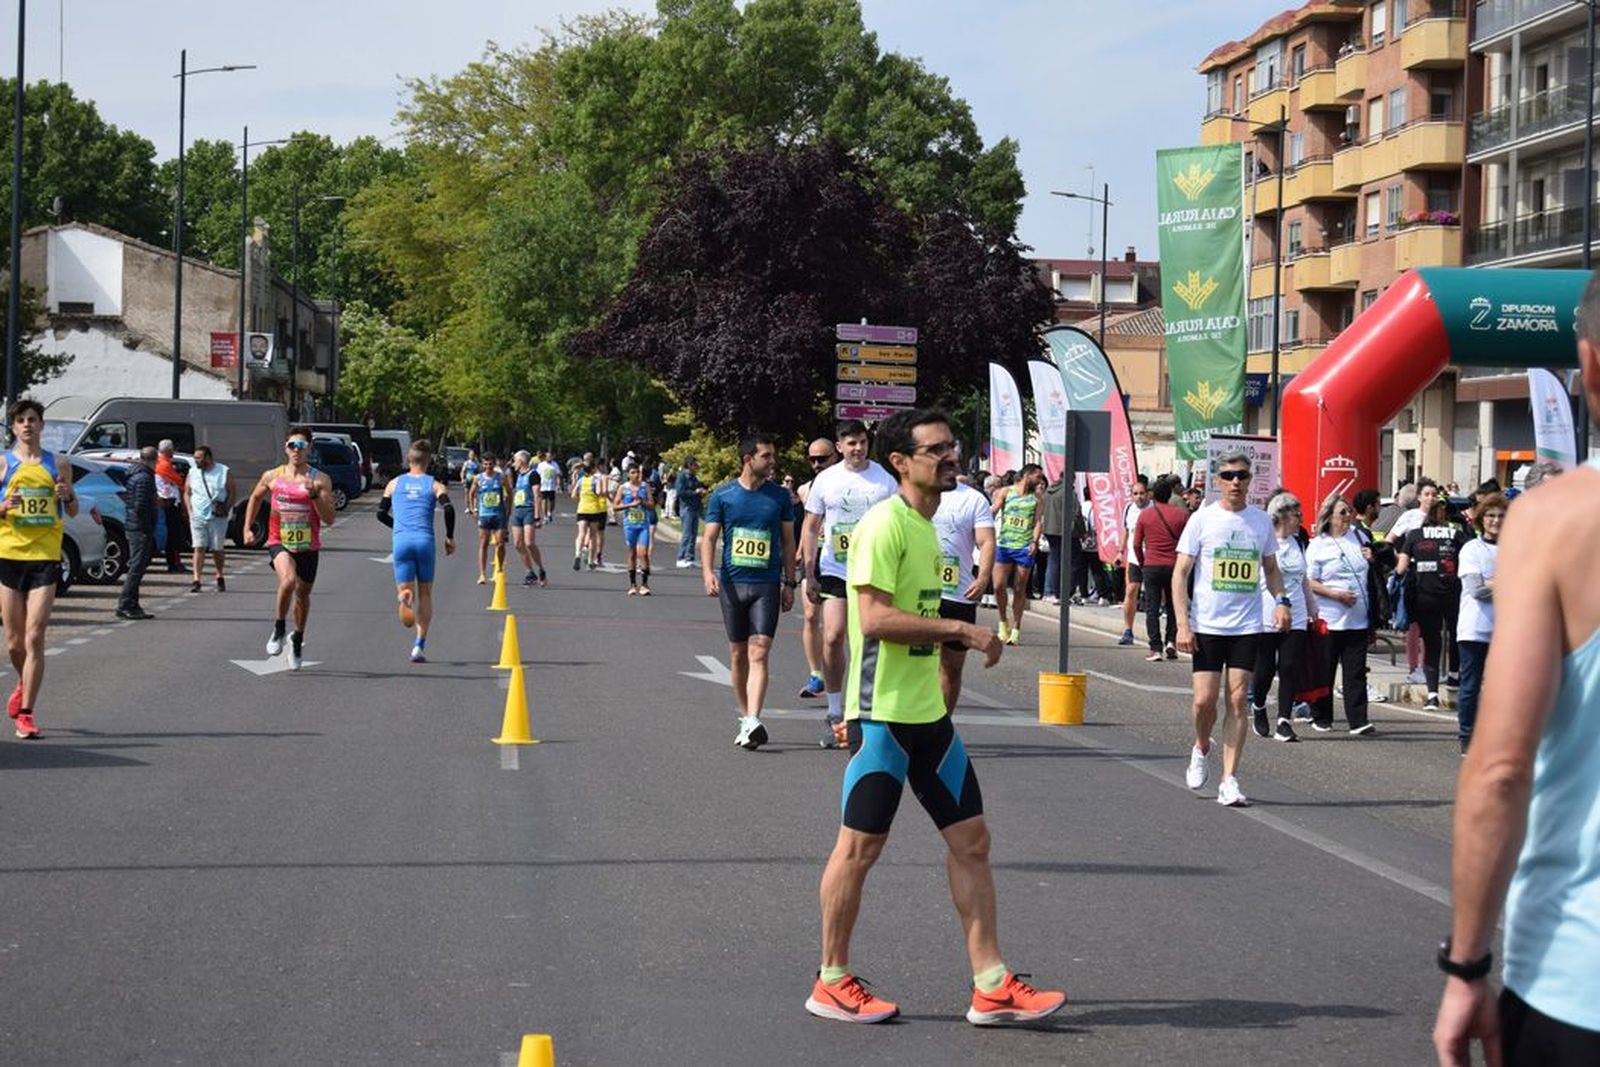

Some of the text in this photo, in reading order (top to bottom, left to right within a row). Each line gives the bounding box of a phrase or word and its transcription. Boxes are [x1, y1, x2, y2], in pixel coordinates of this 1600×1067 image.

[1496, 318, 1559, 332] ZAMORA
[20, 498, 48, 514] 182
[287, 530, 303, 542] 20
[1423, 526, 1456, 539] VICKY
[735, 539, 766, 556] 209
[840, 534, 851, 550] 8
[943, 567, 953, 582] 8
[1218, 561, 1252, 579] 100
